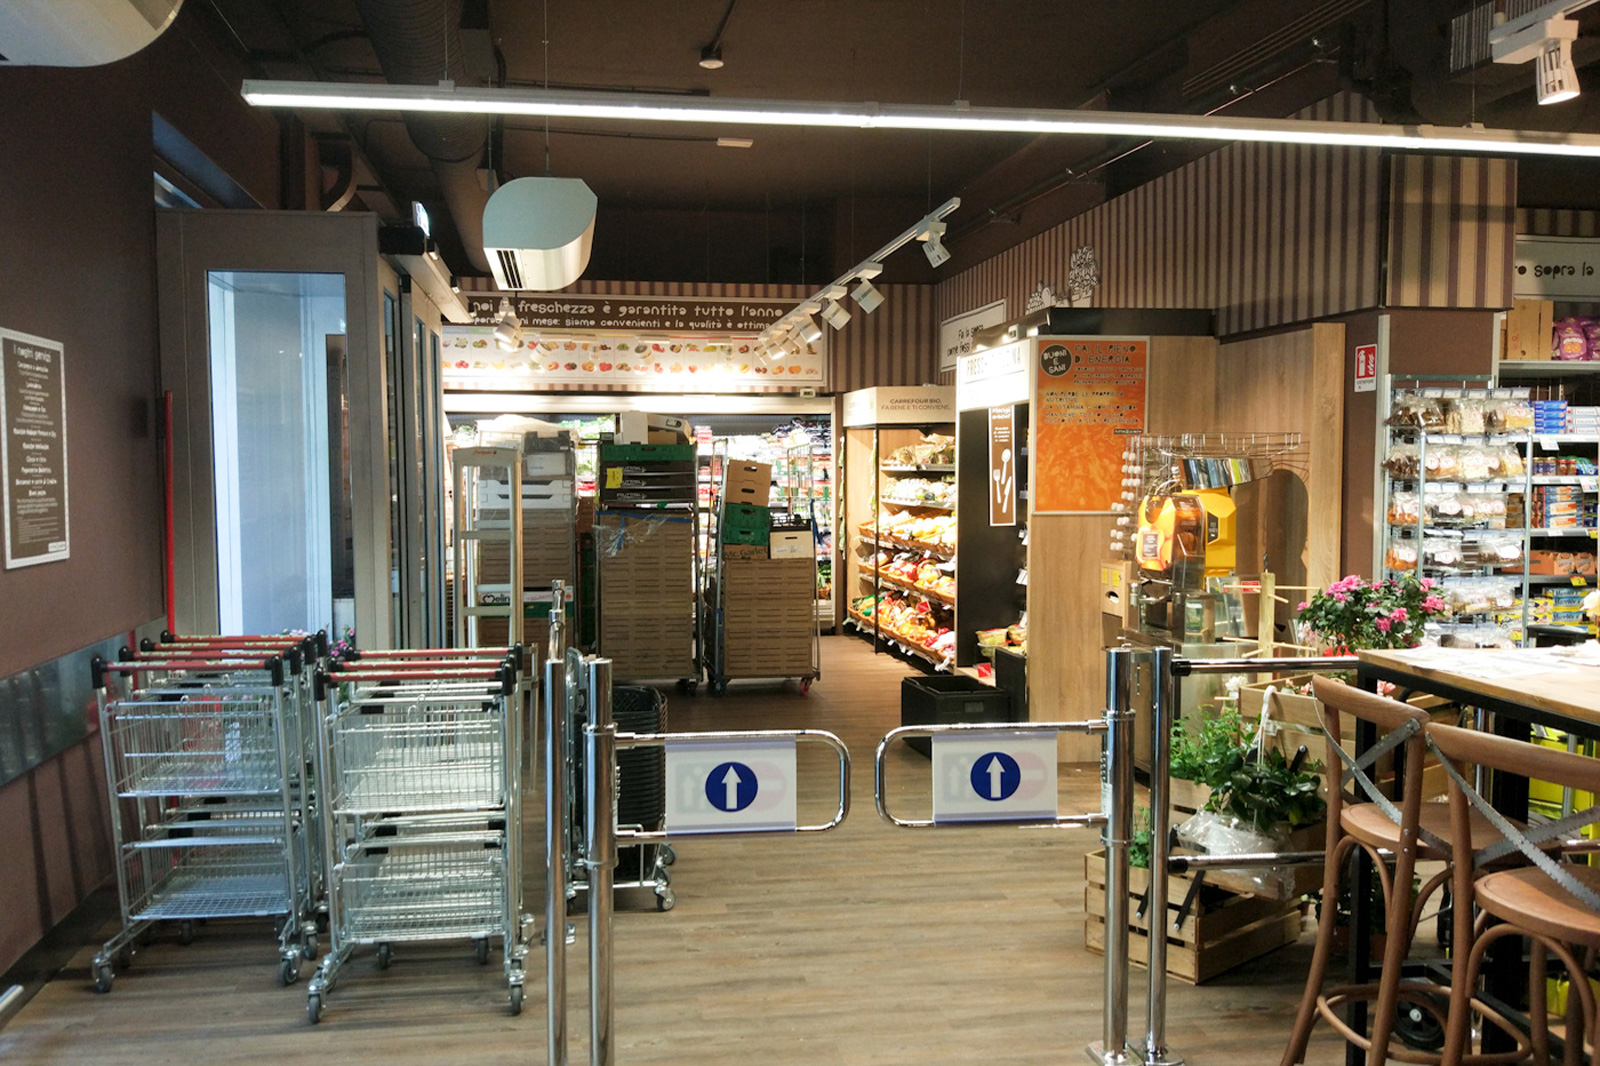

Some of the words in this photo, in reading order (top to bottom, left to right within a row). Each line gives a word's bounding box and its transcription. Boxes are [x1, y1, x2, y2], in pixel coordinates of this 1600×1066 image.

[1514, 265, 1527, 275] o
[1534, 264, 1576, 280] sopra
[1582, 261, 1594, 277] la
[473, 299, 494, 312] noi
[518, 300, 596, 314] freschezza
[602, 301, 611, 314] è
[618, 303, 687, 317] garantita
[694, 304, 734, 317] tutto
[741, 304, 784, 317] l'anno
[565, 317, 596, 327] siamo
[600, 317, 660, 328] convenienti
[664, 320, 671, 328] e
[675, 319, 684, 328] la
[688, 318, 722, 330] qualità
[726, 319, 733, 329] è
[1074, 344, 1090, 352] FAI
[1095, 345, 1102, 353] IL
[1108, 344, 1136, 353] PIENO
[1043, 349, 1067, 360] BUONI
[1074, 355, 1084, 363] DI
[1088, 354, 1130, 364] ENERGIA
[1053, 358, 1059, 366] E
[1048, 364, 1066, 374] SANI
[482, 593, 510, 604] Melin
